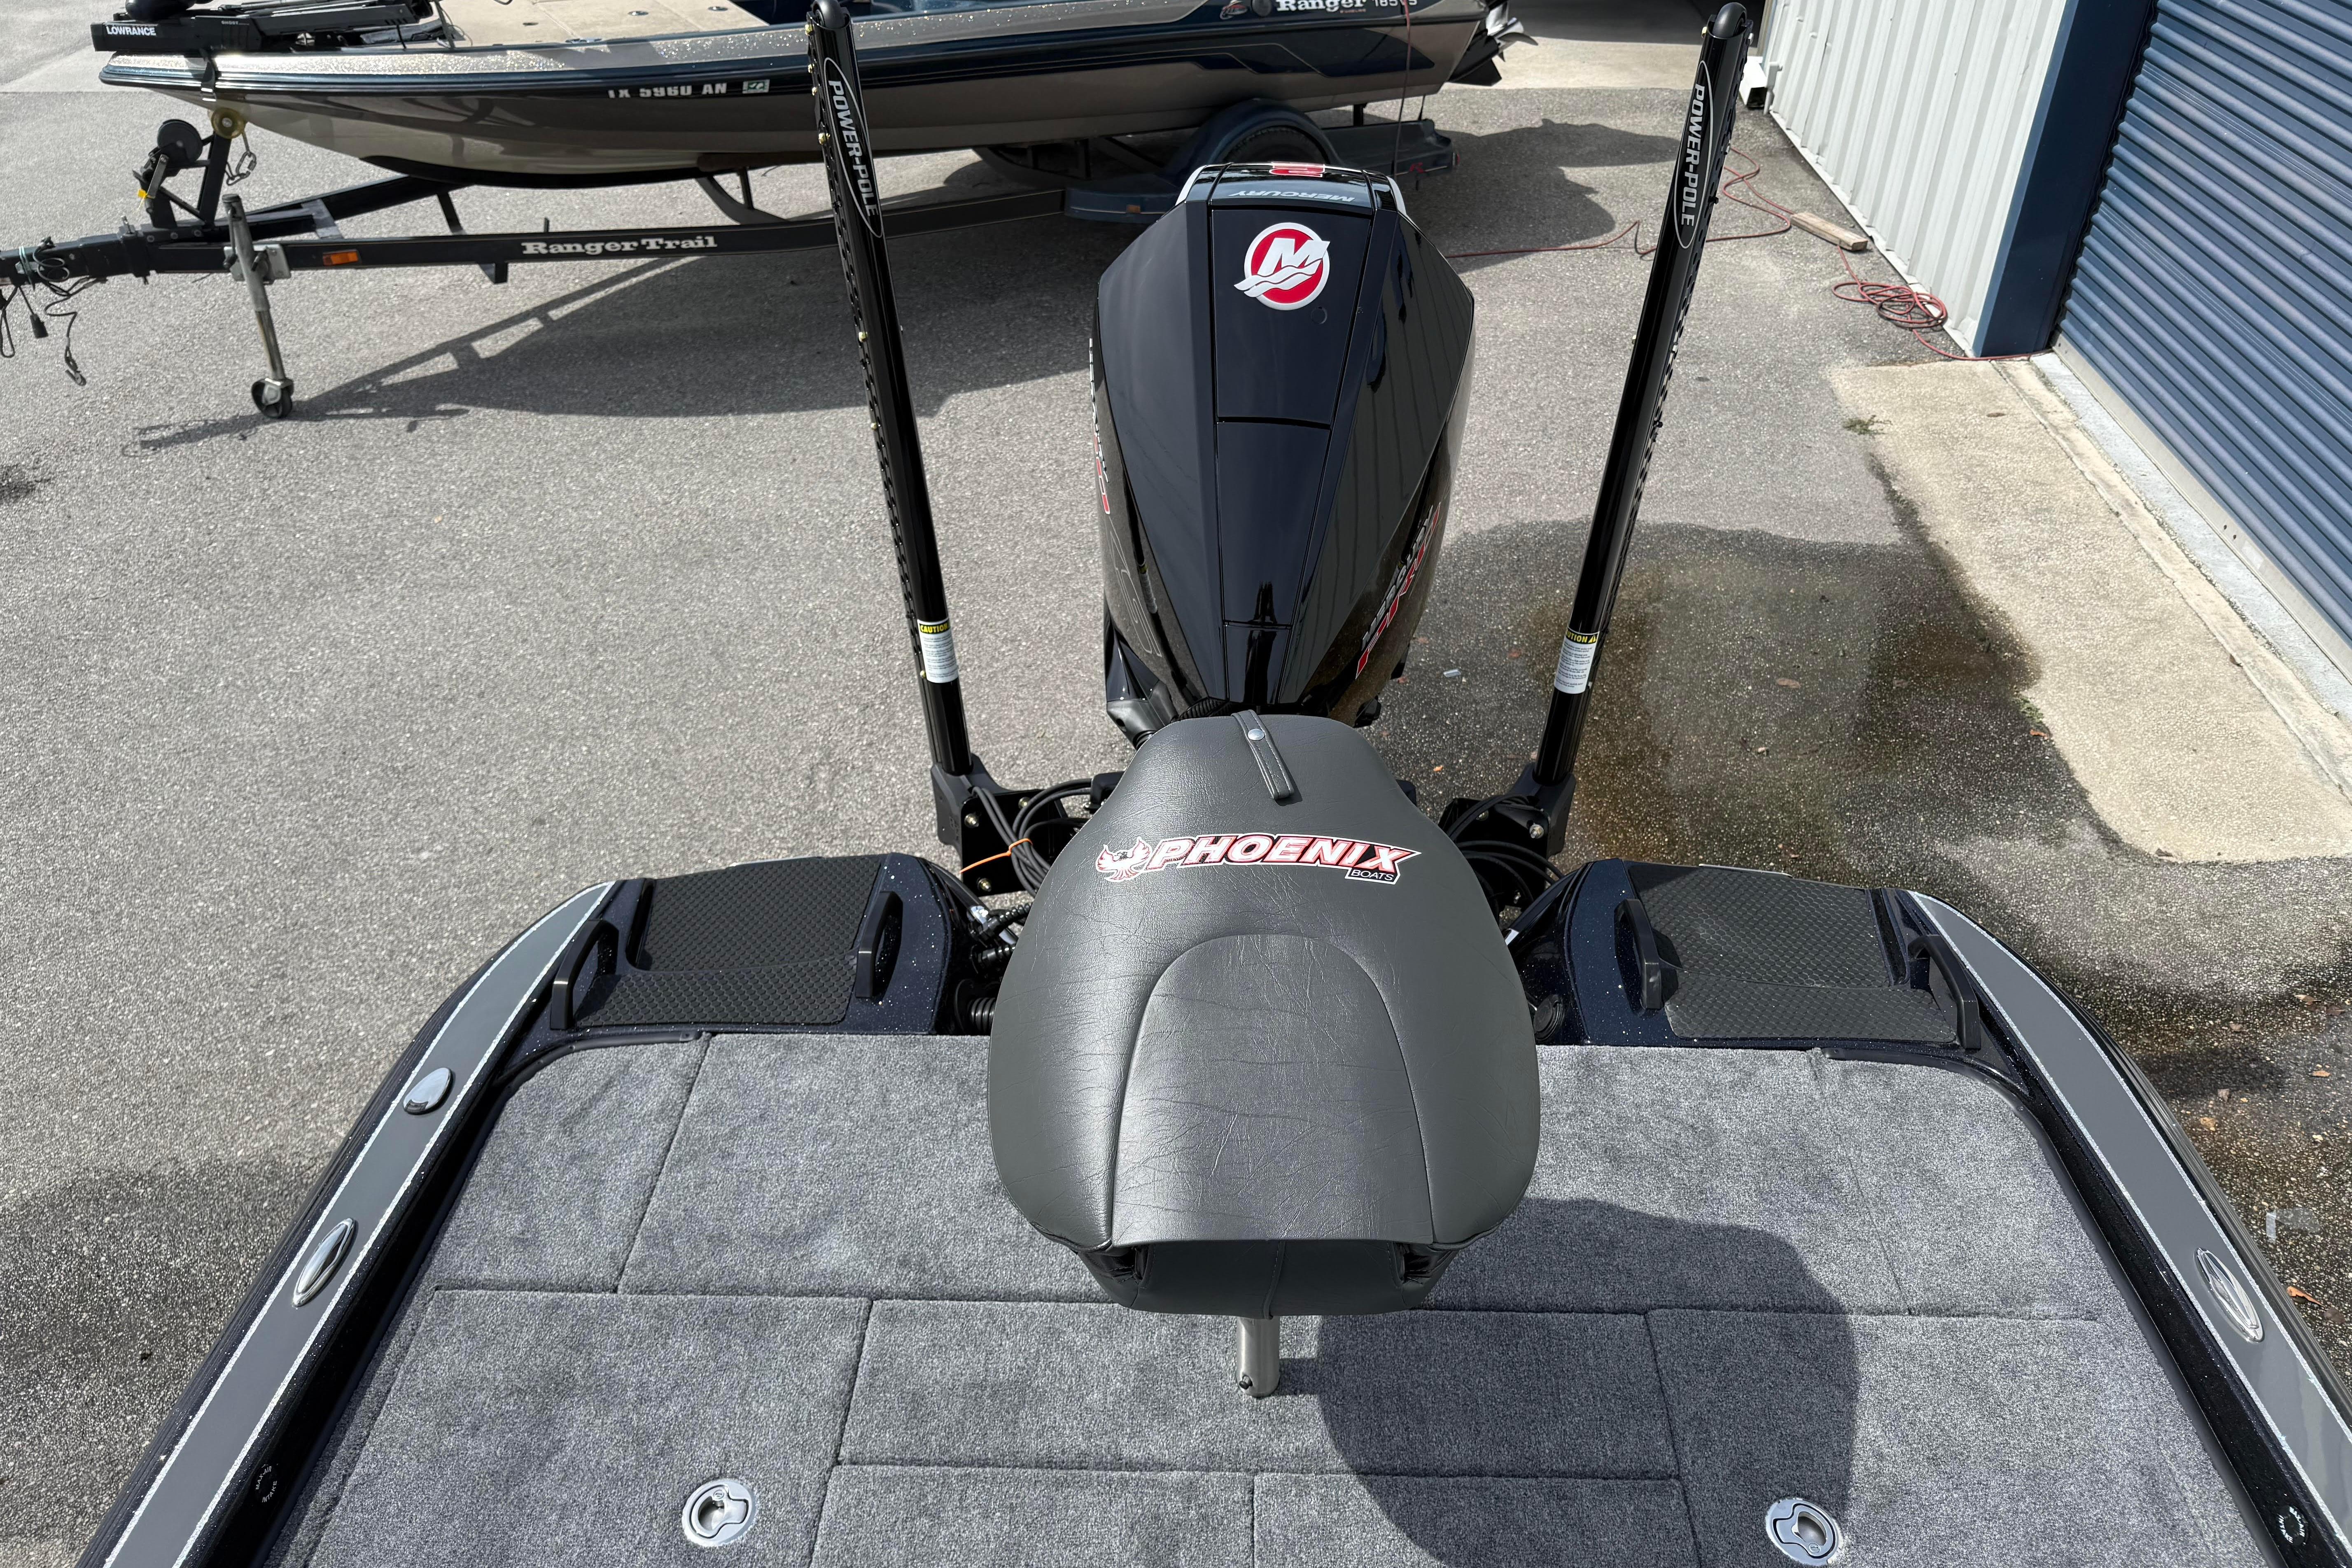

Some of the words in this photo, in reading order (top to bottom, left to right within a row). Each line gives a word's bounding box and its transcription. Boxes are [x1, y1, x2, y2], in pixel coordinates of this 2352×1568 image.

[1277, 0, 1366, 12] Ranger
[106, 26, 156, 36] LOWRANCE
[702, 82, 727, 95] AN
[828, 80, 879, 217] POWER-POLE
[1681, 83, 1705, 226] POWER-POLE
[1228, 191, 1356, 202] MERCURY
[521, 241, 639, 255] Ranger
[641, 236, 718, 250] Trail
[920, 622, 948, 633] CAUTION
[1146, 835, 1416, 873] PHOENIX
[1350, 869, 1395, 881] BOATS
[262, 1480, 278, 1503] INTAKE
[2277, 1513, 2293, 1544] INTAKE
